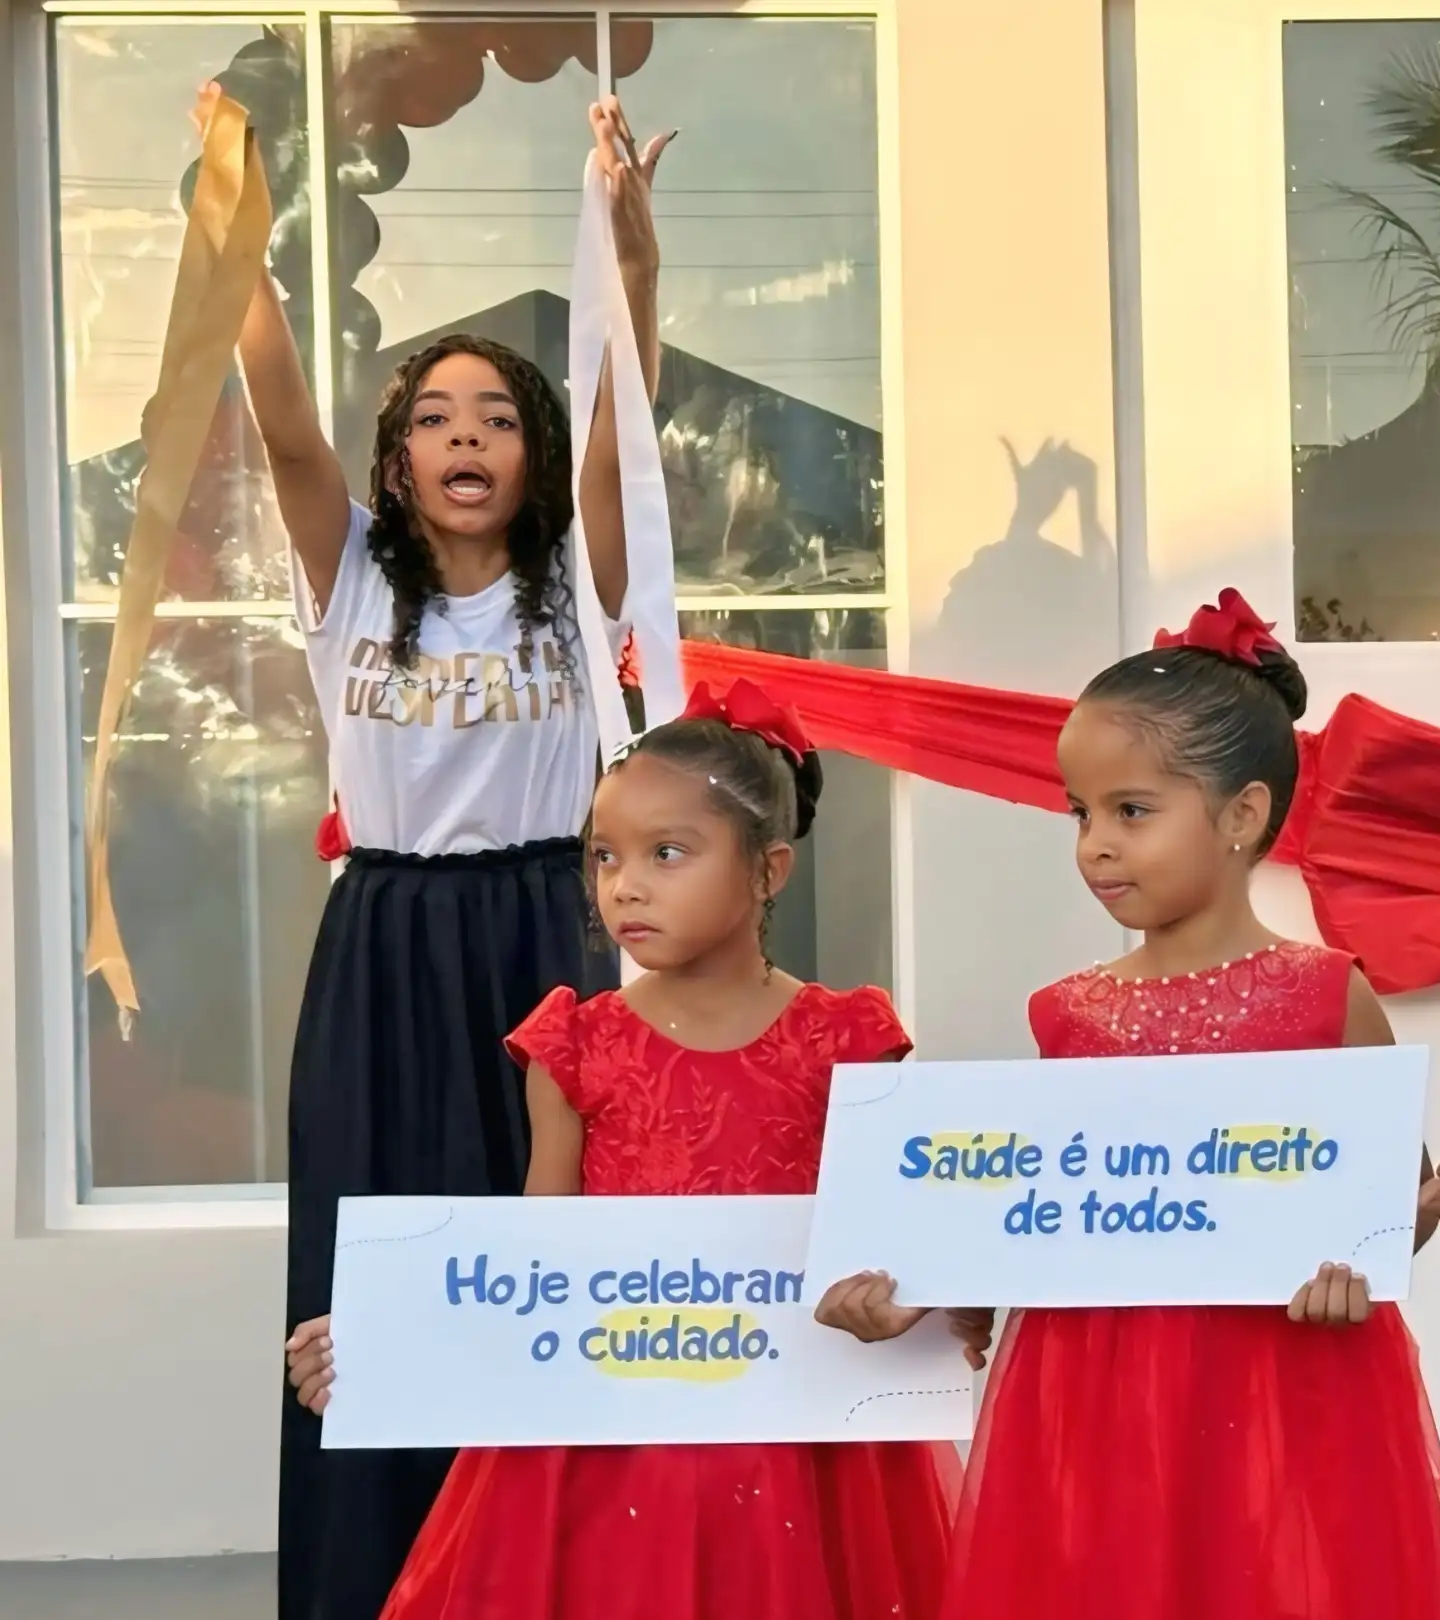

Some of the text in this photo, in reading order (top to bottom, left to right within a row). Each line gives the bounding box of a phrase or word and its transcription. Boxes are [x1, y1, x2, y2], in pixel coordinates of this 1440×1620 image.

[899, 1127, 1339, 1180] Saúde é um direito
[1004, 1186, 1217, 1235] de todos.
[445, 1254, 570, 1316] Hoje
[531, 1315, 779, 1362] o cuidado.
